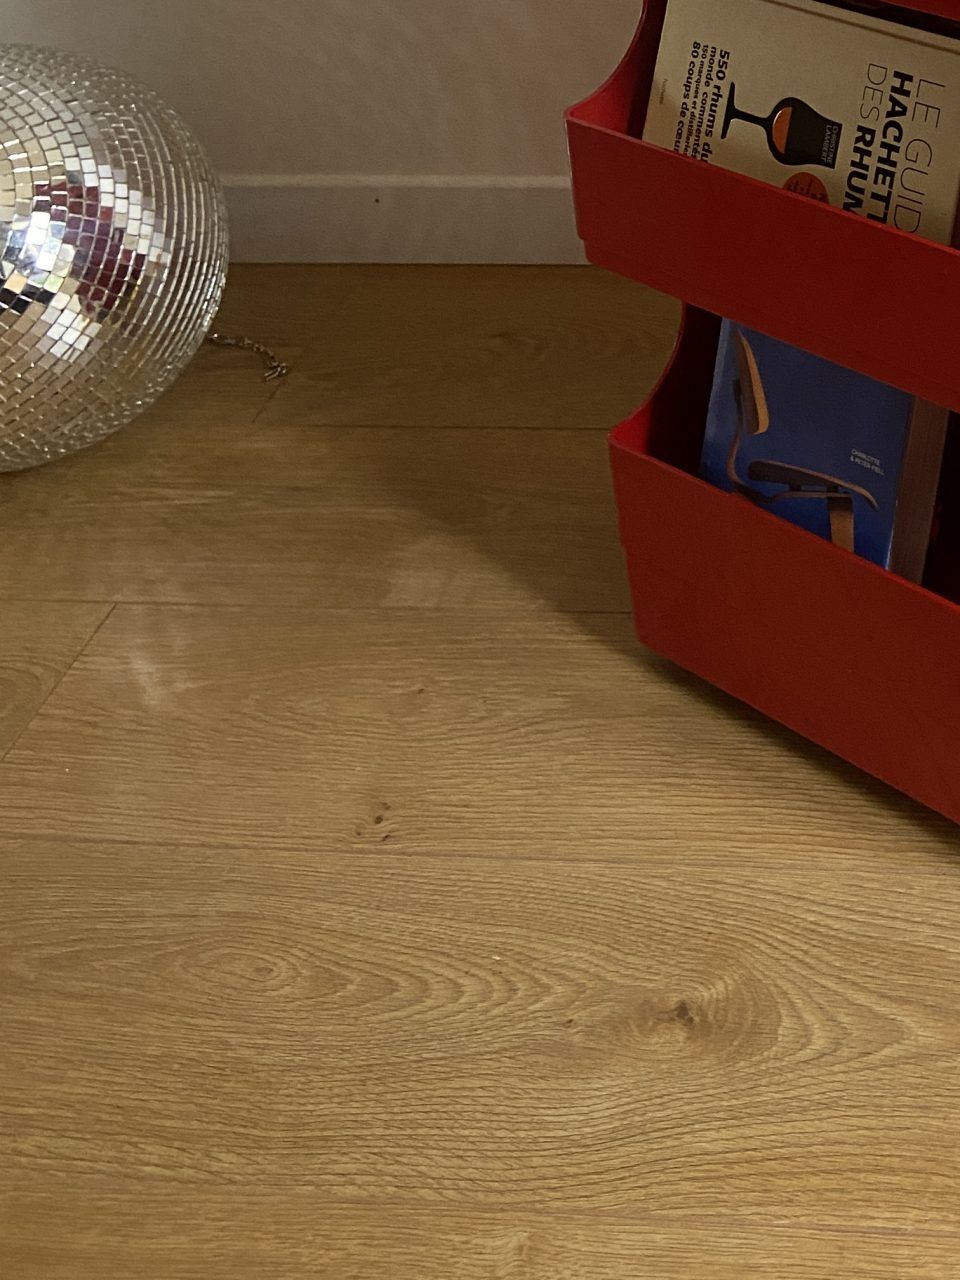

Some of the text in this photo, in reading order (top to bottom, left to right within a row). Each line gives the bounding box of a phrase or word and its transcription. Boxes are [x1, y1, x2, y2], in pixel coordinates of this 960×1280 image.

[691, 41, 701, 59] 80
[700, 44, 709, 59] 150
[704, 46, 717, 87] monde
[682, 60, 696, 100] coups
[693, 60, 705, 99] marques
[680, 101, 690, 118] de
[691, 100, 698, 110] et
[700, 49, 731, 163] 550 rhums du
[820, 124, 832, 163] LAMBERT
[842, 63, 888, 215] DES RHUM
[866, 70, 914, 225] HACHETT
[893, 78, 946, 234] LE GUID
